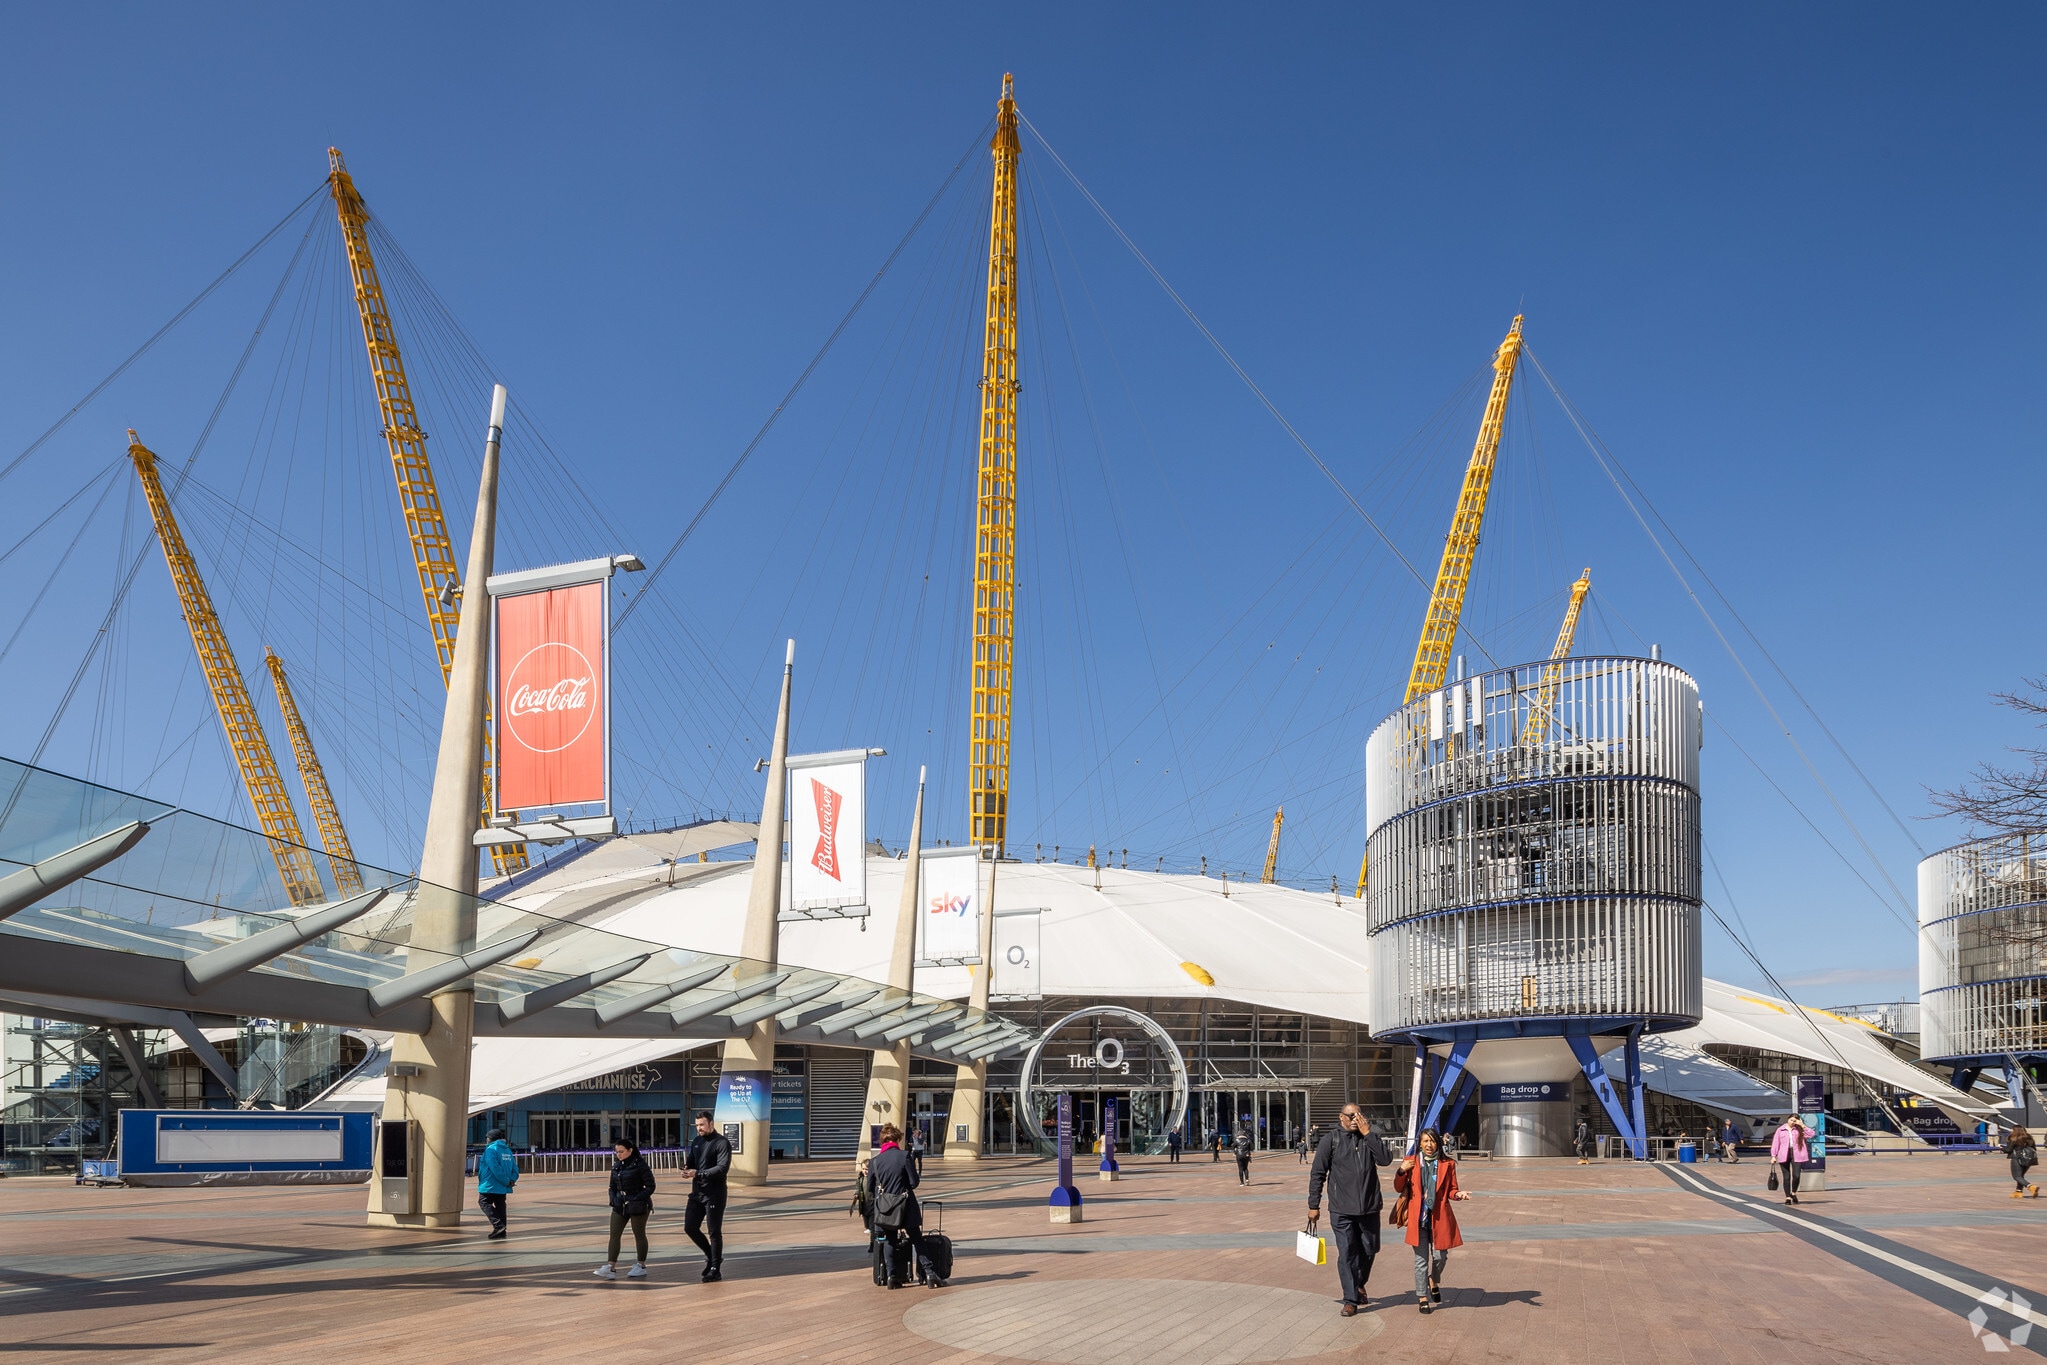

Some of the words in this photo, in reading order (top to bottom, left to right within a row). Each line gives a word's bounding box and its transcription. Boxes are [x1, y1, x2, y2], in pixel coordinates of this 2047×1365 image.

[510, 677, 591, 717] Coca-Cola
[818, 785, 834, 876] Budweiser
[930, 891, 972, 918] sky
[1006, 945, 1031, 969] O2
[1067, 1053, 1096, 1068] The
[729, 1084, 745, 1092] Ready
[1500, 1086, 1516, 1095] Bag
[1517, 1085, 1539, 1094] drop
[1913, 1117, 1932, 1126] Bag
